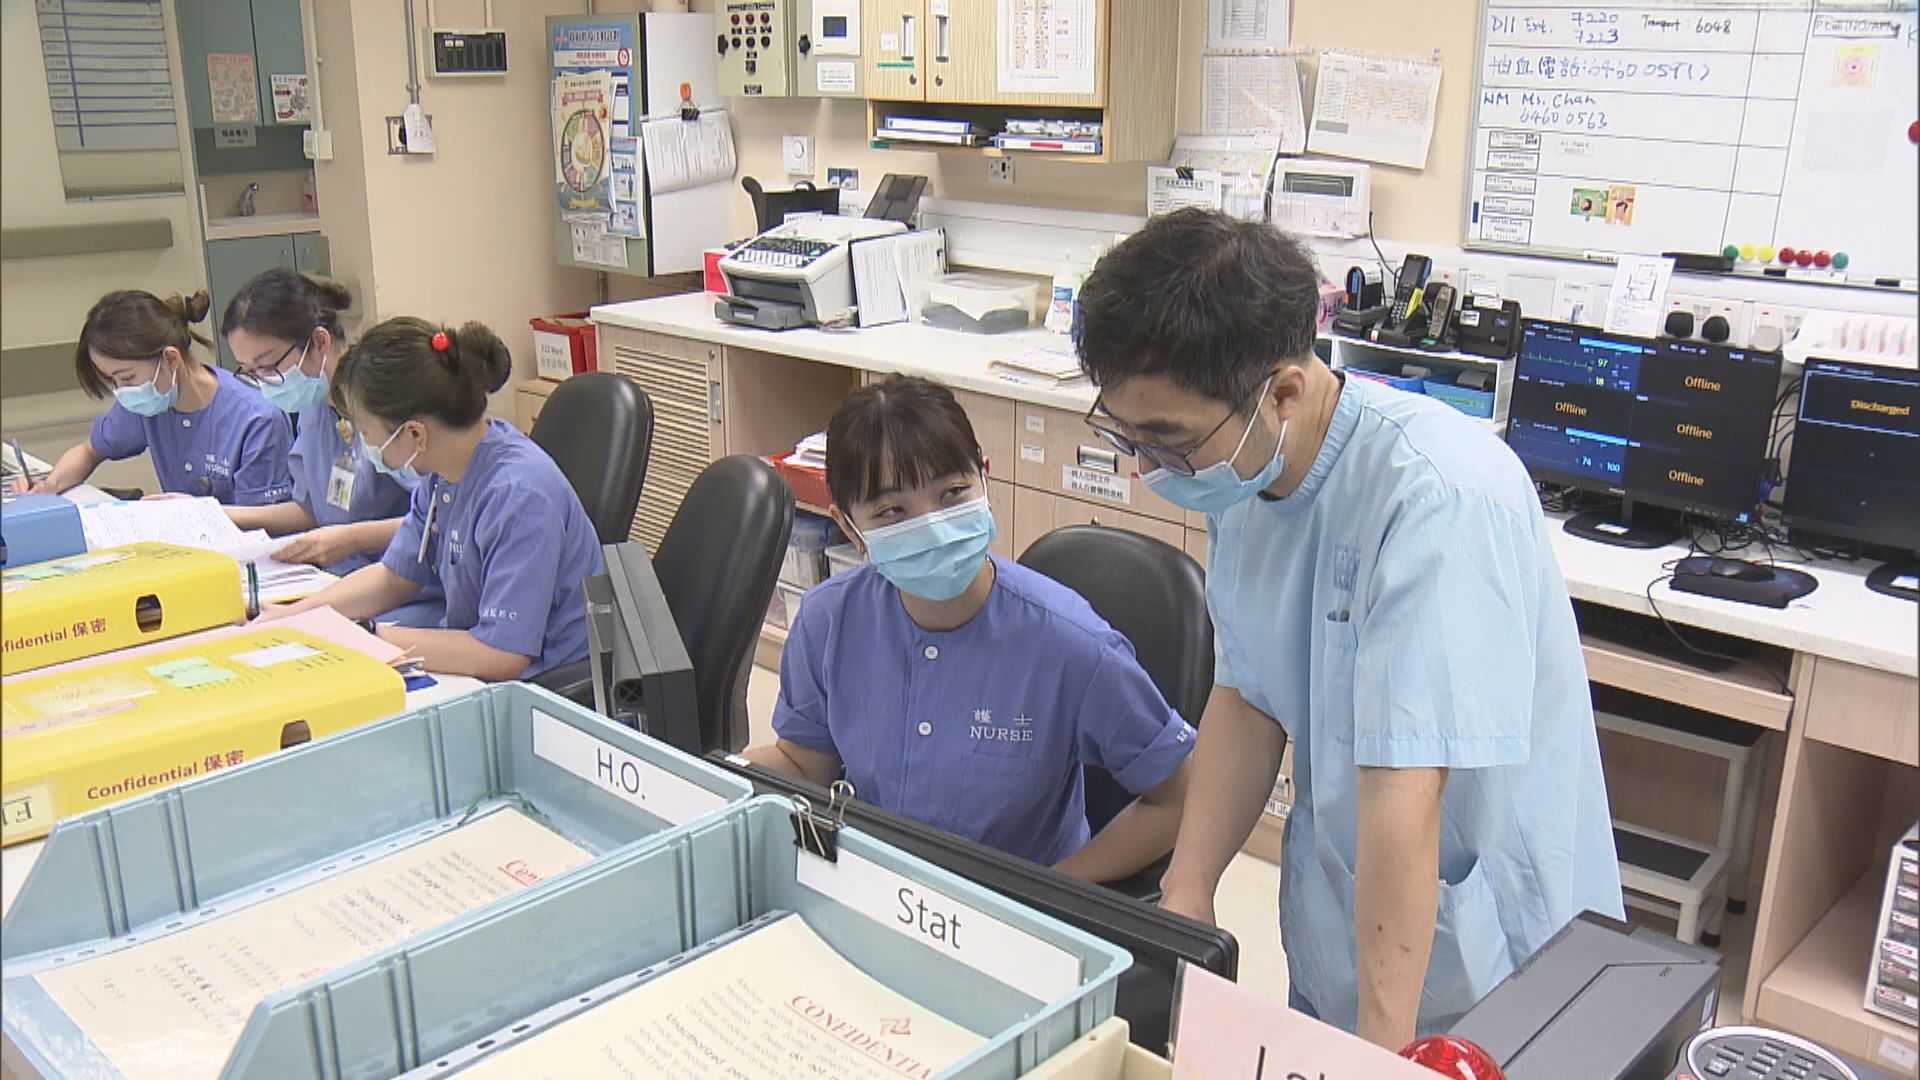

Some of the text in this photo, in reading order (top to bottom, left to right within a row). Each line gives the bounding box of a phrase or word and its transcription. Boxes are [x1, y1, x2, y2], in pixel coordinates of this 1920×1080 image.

[1684, 375, 1721, 392] Offline
[1554, 401, 1588, 416] Offline
[1676, 423, 1713, 440] Offline
[1668, 469, 1704, 486] Offline
[72, 618, 107, 638] 保密
[970, 725, 1033, 743] NURSE
[86, 749, 244, 800] Confidential 保密
[597, 747, 646, 801] H.O.
[896, 887, 962, 950] Stat
